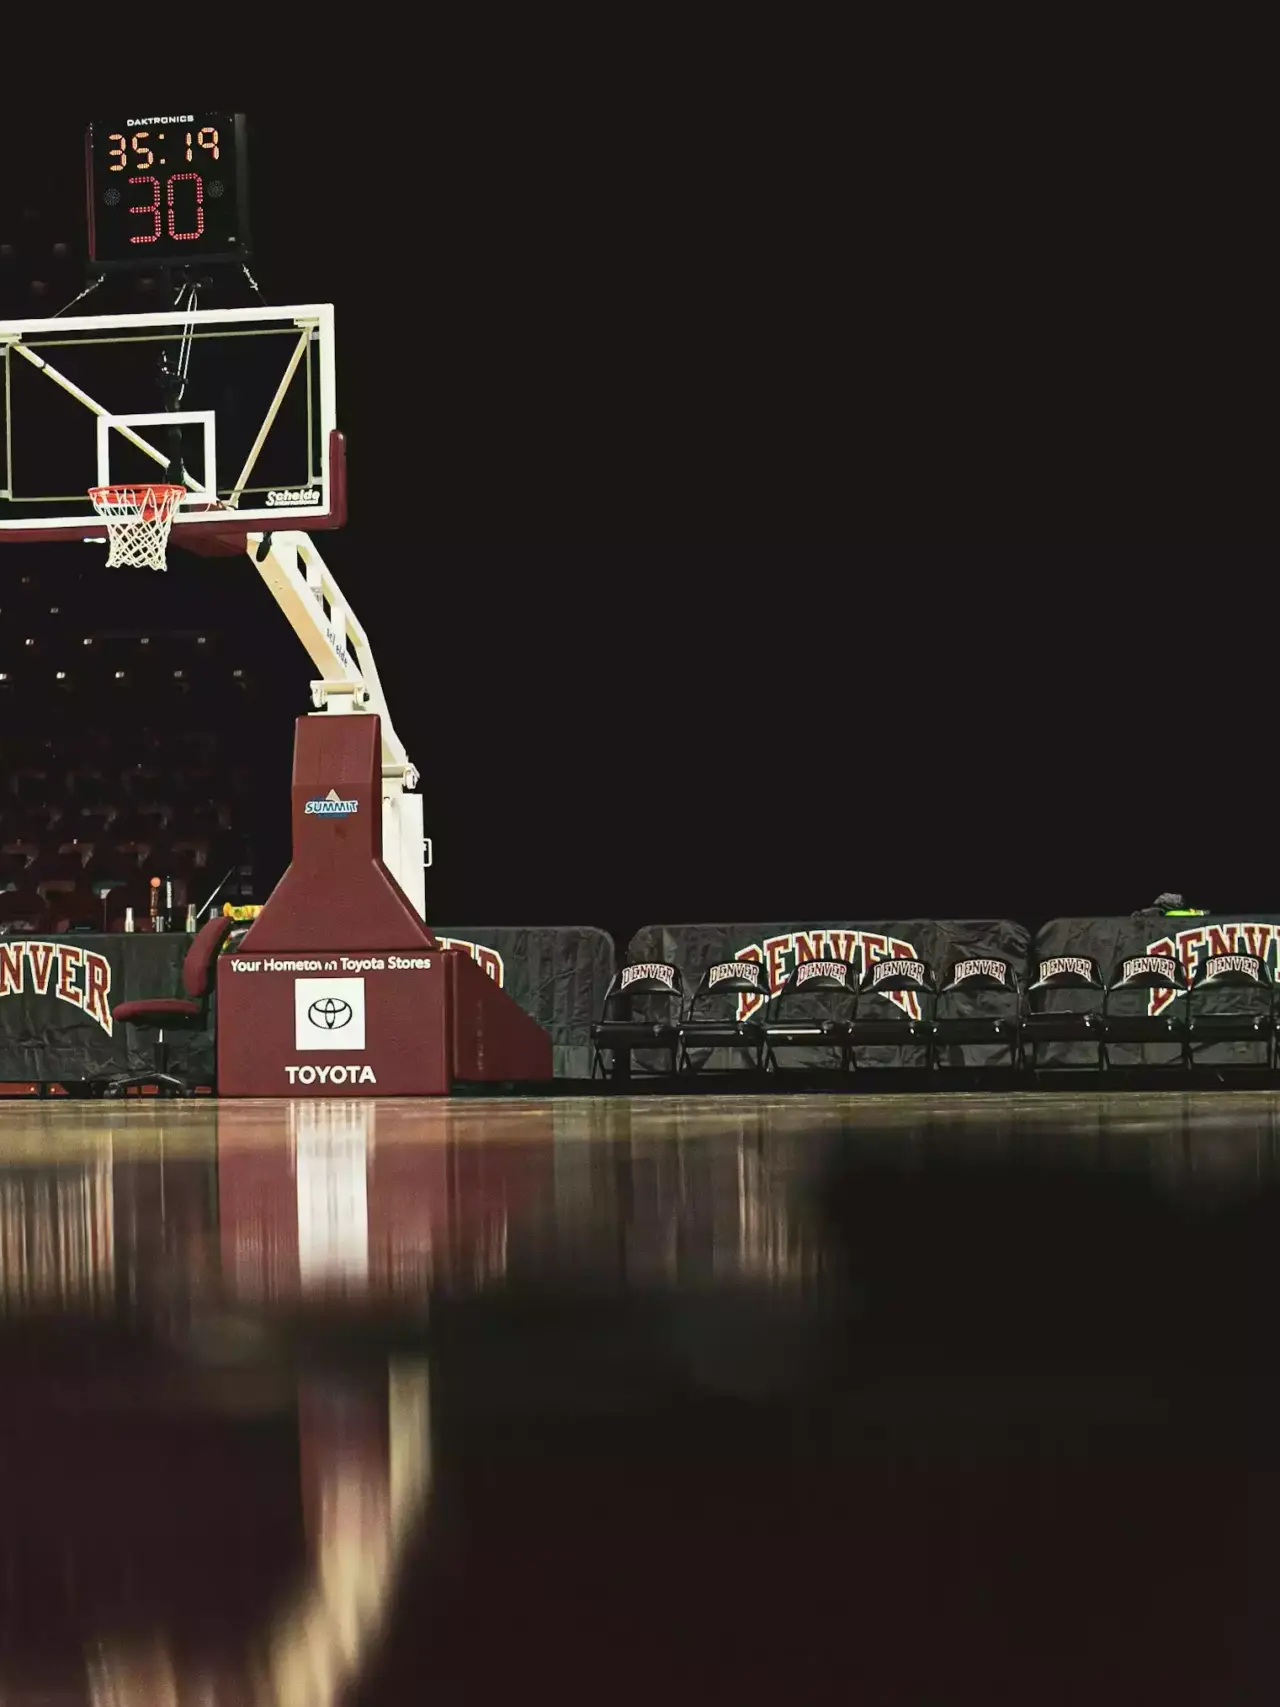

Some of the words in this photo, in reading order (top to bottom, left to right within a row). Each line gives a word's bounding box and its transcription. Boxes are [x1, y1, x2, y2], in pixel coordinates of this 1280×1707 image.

[126, 114, 194, 127] DAKTRONICS
[108, 127, 219, 171] 35:19
[128, 172, 204, 244] 30
[304, 800, 358, 814] SUMMIT
[231, 960, 260, 972] Your
[340, 957, 385, 972] Toyota
[387, 956, 431, 969] Stores
[621, 963, 674, 990] DENVER
[708, 963, 759, 988] DENVER
[796, 961, 847, 987] DENVER
[873, 959, 924, 985] DENVER
[954, 957, 1006, 984] DENVER
[1039, 957, 1092, 982] DENVER
[1123, 957, 1176, 983] DENVER
[1206, 955, 1259, 981] DENVER
[285, 1065, 376, 1084] TOYOTA
